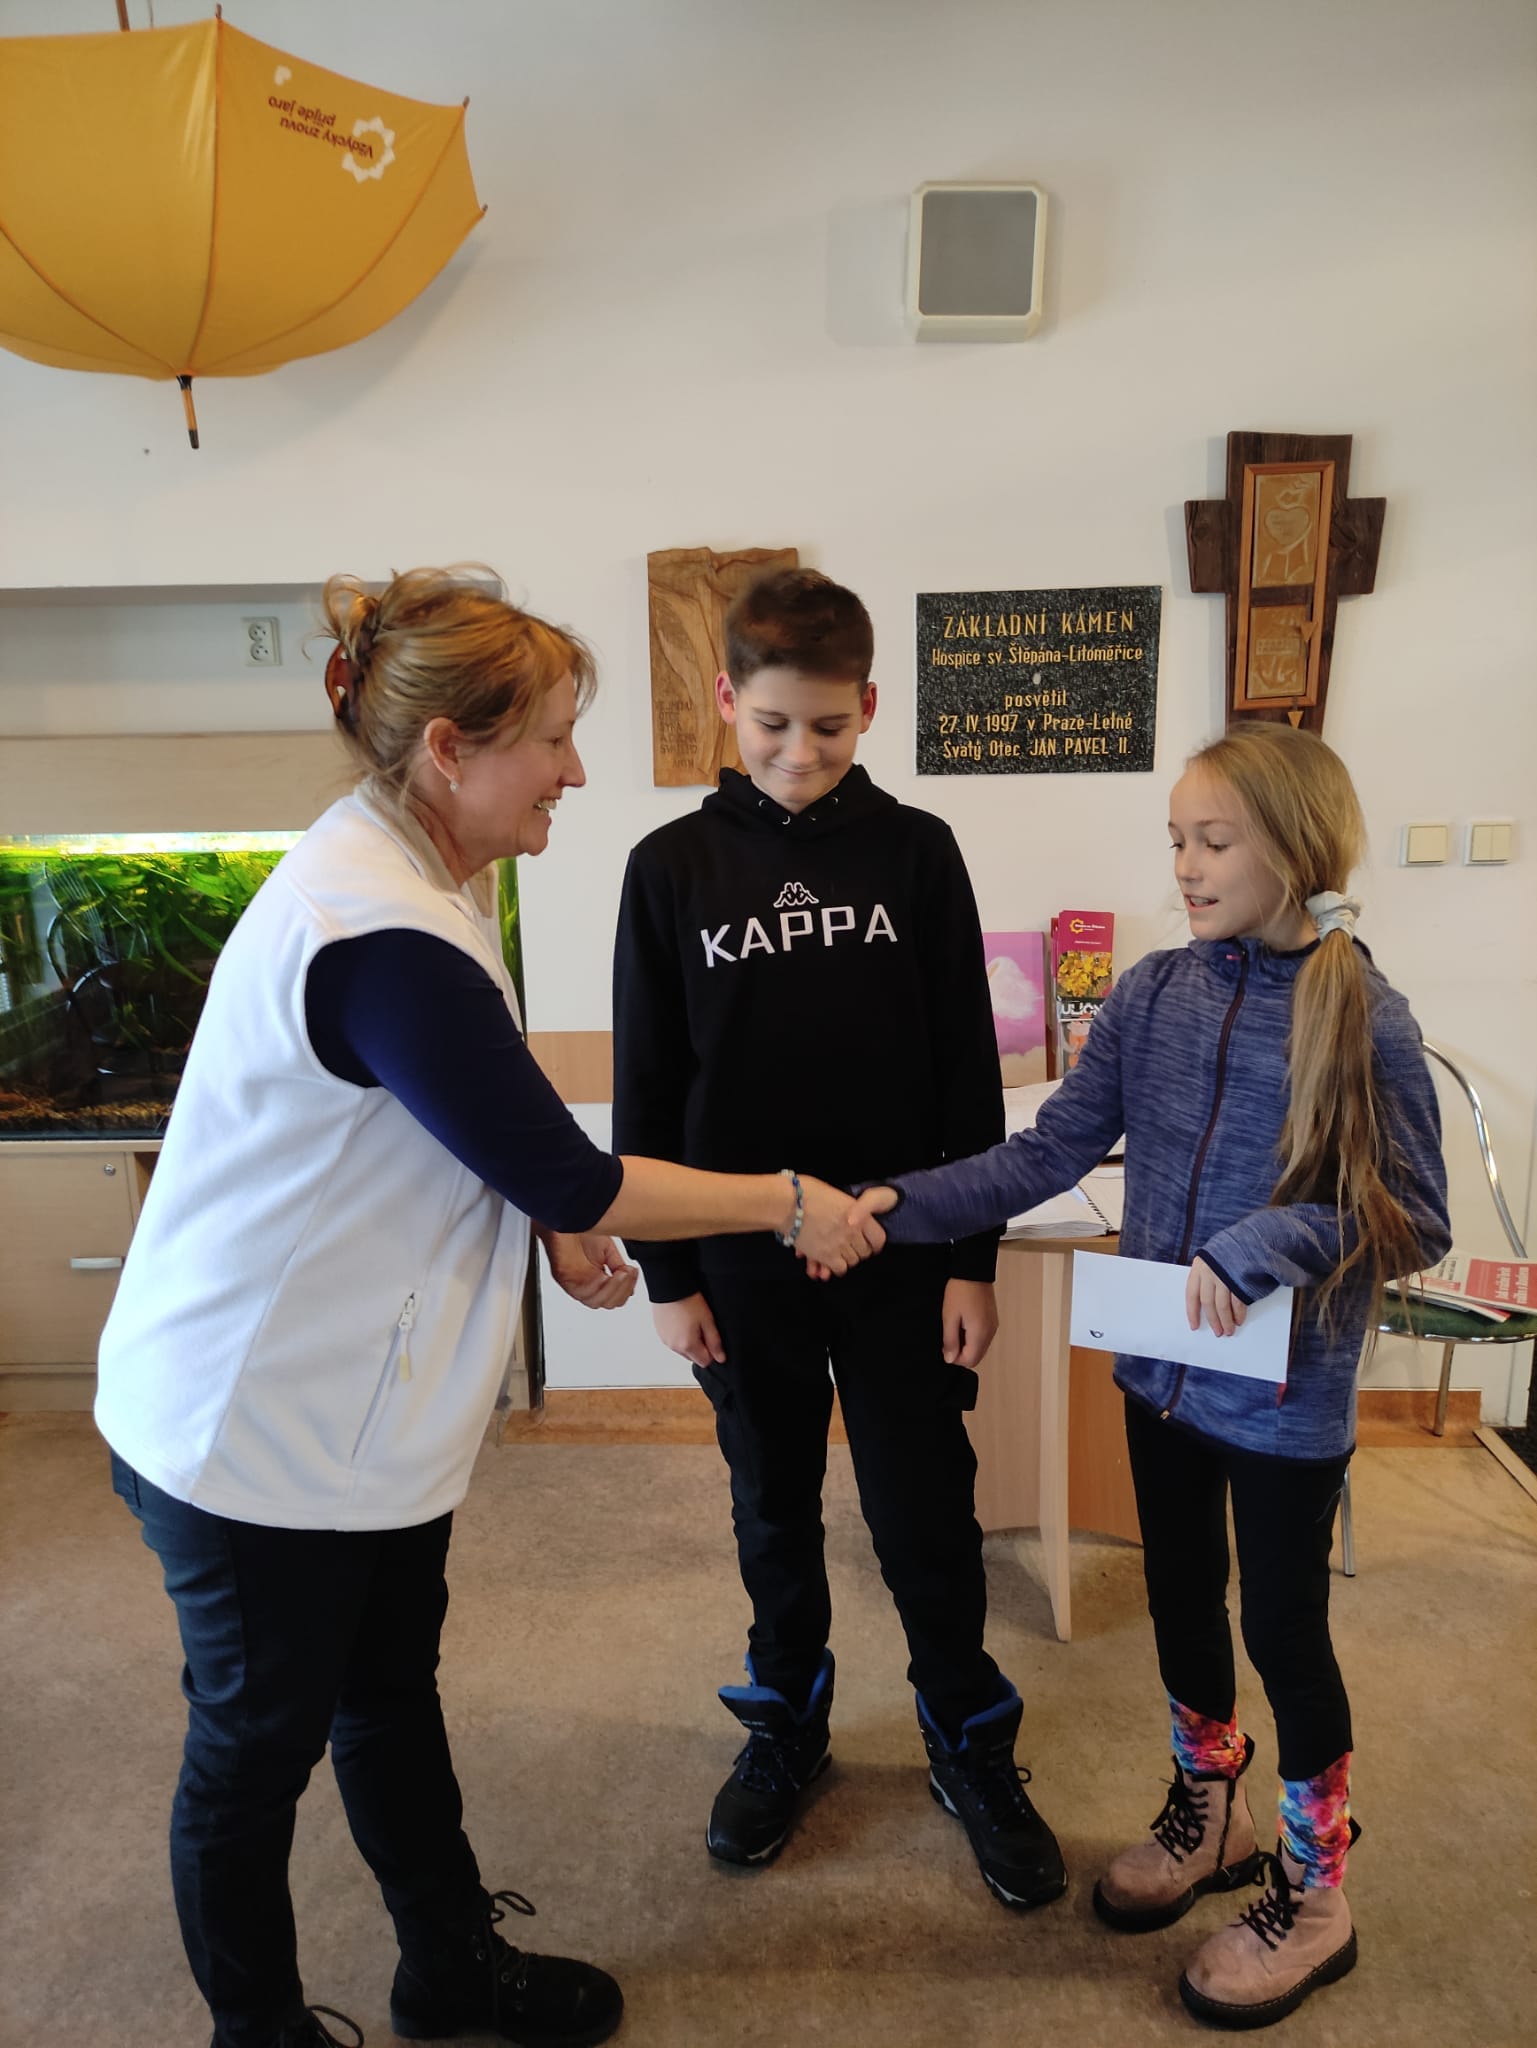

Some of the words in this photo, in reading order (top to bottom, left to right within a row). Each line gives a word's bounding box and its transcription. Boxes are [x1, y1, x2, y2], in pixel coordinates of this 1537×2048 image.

[268, 96, 297, 117] jaro
[279, 117, 320, 139] znovu
[943, 608, 1047, 639] ZÁKLADNÍ
[1061, 604, 1134, 635] KÁMEN
[932, 648, 981, 669] Hospice
[988, 652, 1006, 665] sv.
[1005, 689, 1068, 711] posvětil
[984, 714, 1019, 733] 1997
[1027, 719, 1036, 731] v
[943, 740, 982, 761] Svatý
[989, 740, 1021, 757] Otec
[1029, 738, 1057, 756] JAN
[1064, 737, 1109, 755] PAVEL
[700, 903, 898, 968] KAPPA
